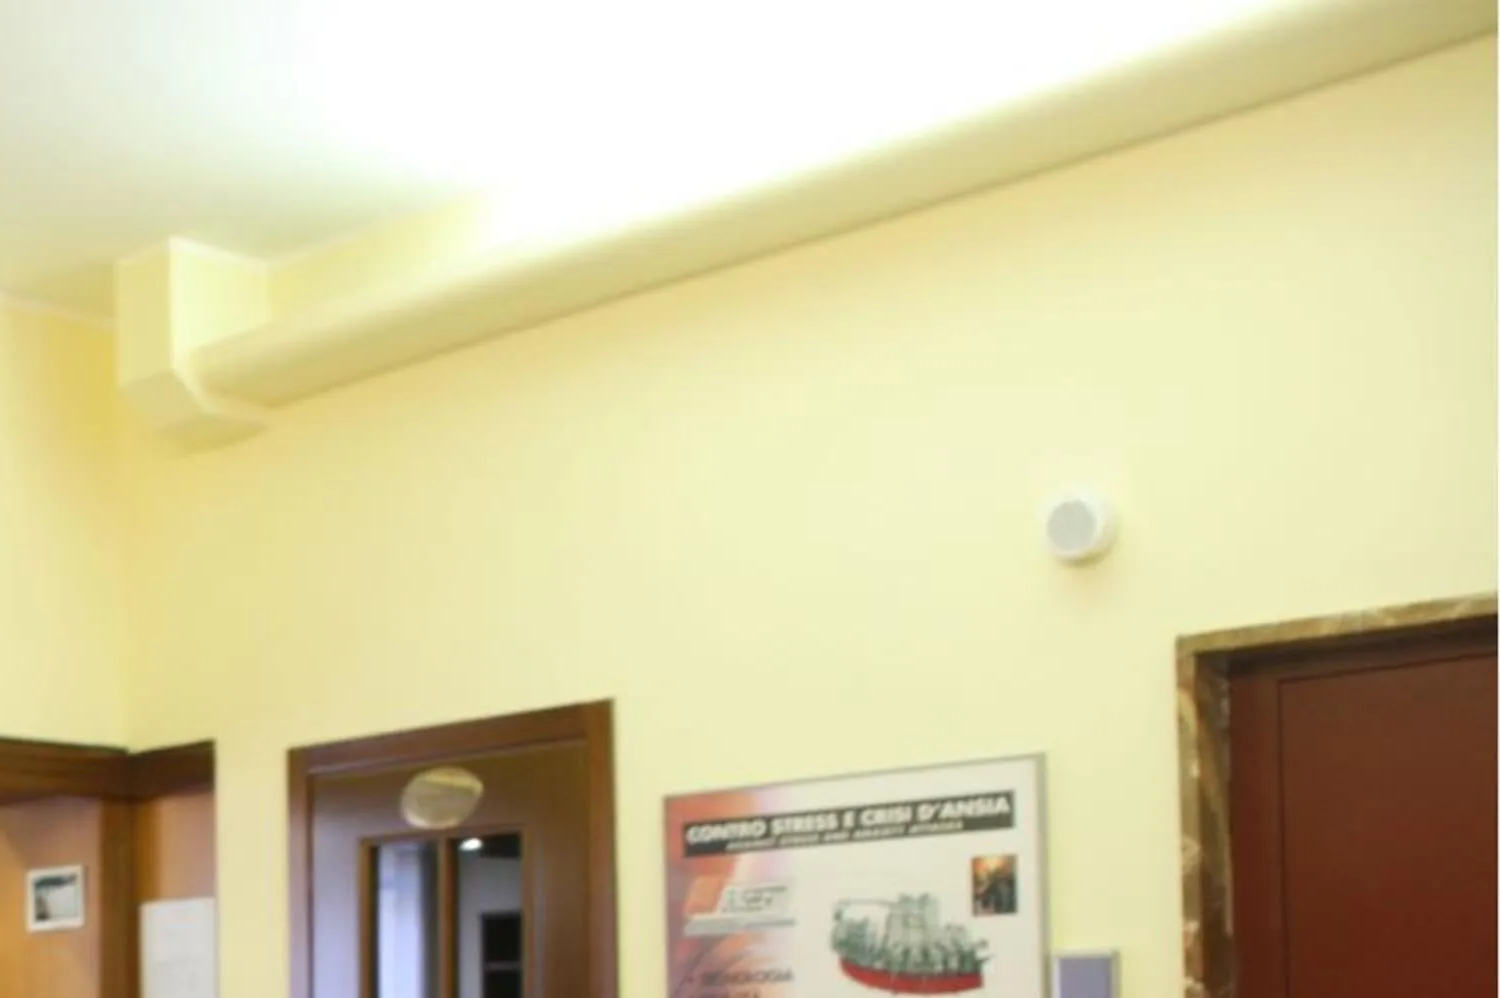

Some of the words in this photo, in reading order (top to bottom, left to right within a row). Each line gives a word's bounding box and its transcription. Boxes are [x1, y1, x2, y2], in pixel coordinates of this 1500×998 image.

[686, 819, 767, 845] CONTRO
[770, 811, 839, 836] STRESS
[843, 808, 855, 829] E
